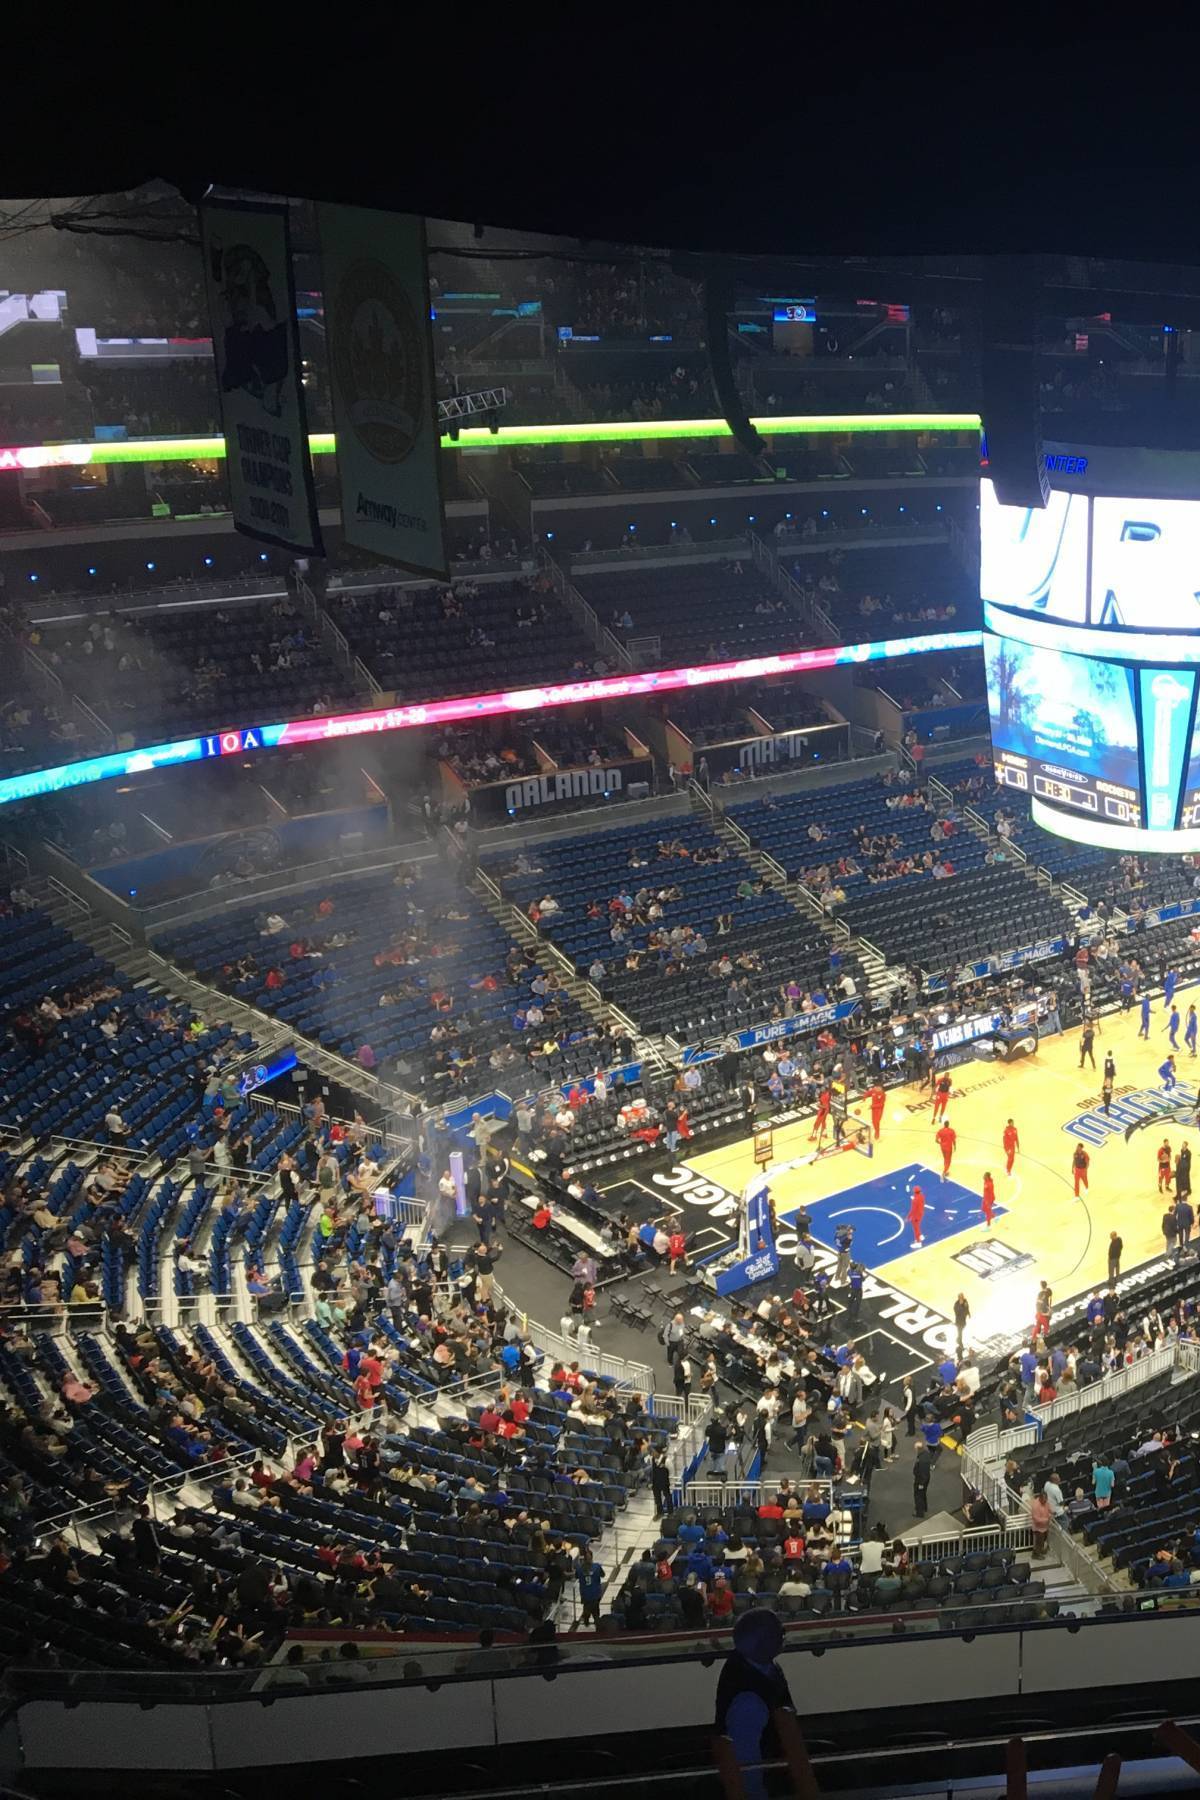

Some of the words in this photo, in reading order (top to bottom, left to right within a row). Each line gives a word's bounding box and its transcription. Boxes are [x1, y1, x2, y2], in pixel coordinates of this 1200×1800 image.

[1044, 455, 1088, 475] NTER
[356, 491, 398, 528] Amway
[207, 731, 259, 756] IOA
[505, 769, 622, 810] ORLANDO
[1023, 944, 1055, 961] MAGIC
[755, 1023, 786, 1043] PURE
[799, 1008, 836, 1028] MAGIC
[938, 1025, 964, 1048] YEARS
[965, 1075, 1006, 1095] CENTER
[771, 1107, 802, 1126] YEARS
[652, 1166, 742, 1229] AGIC
